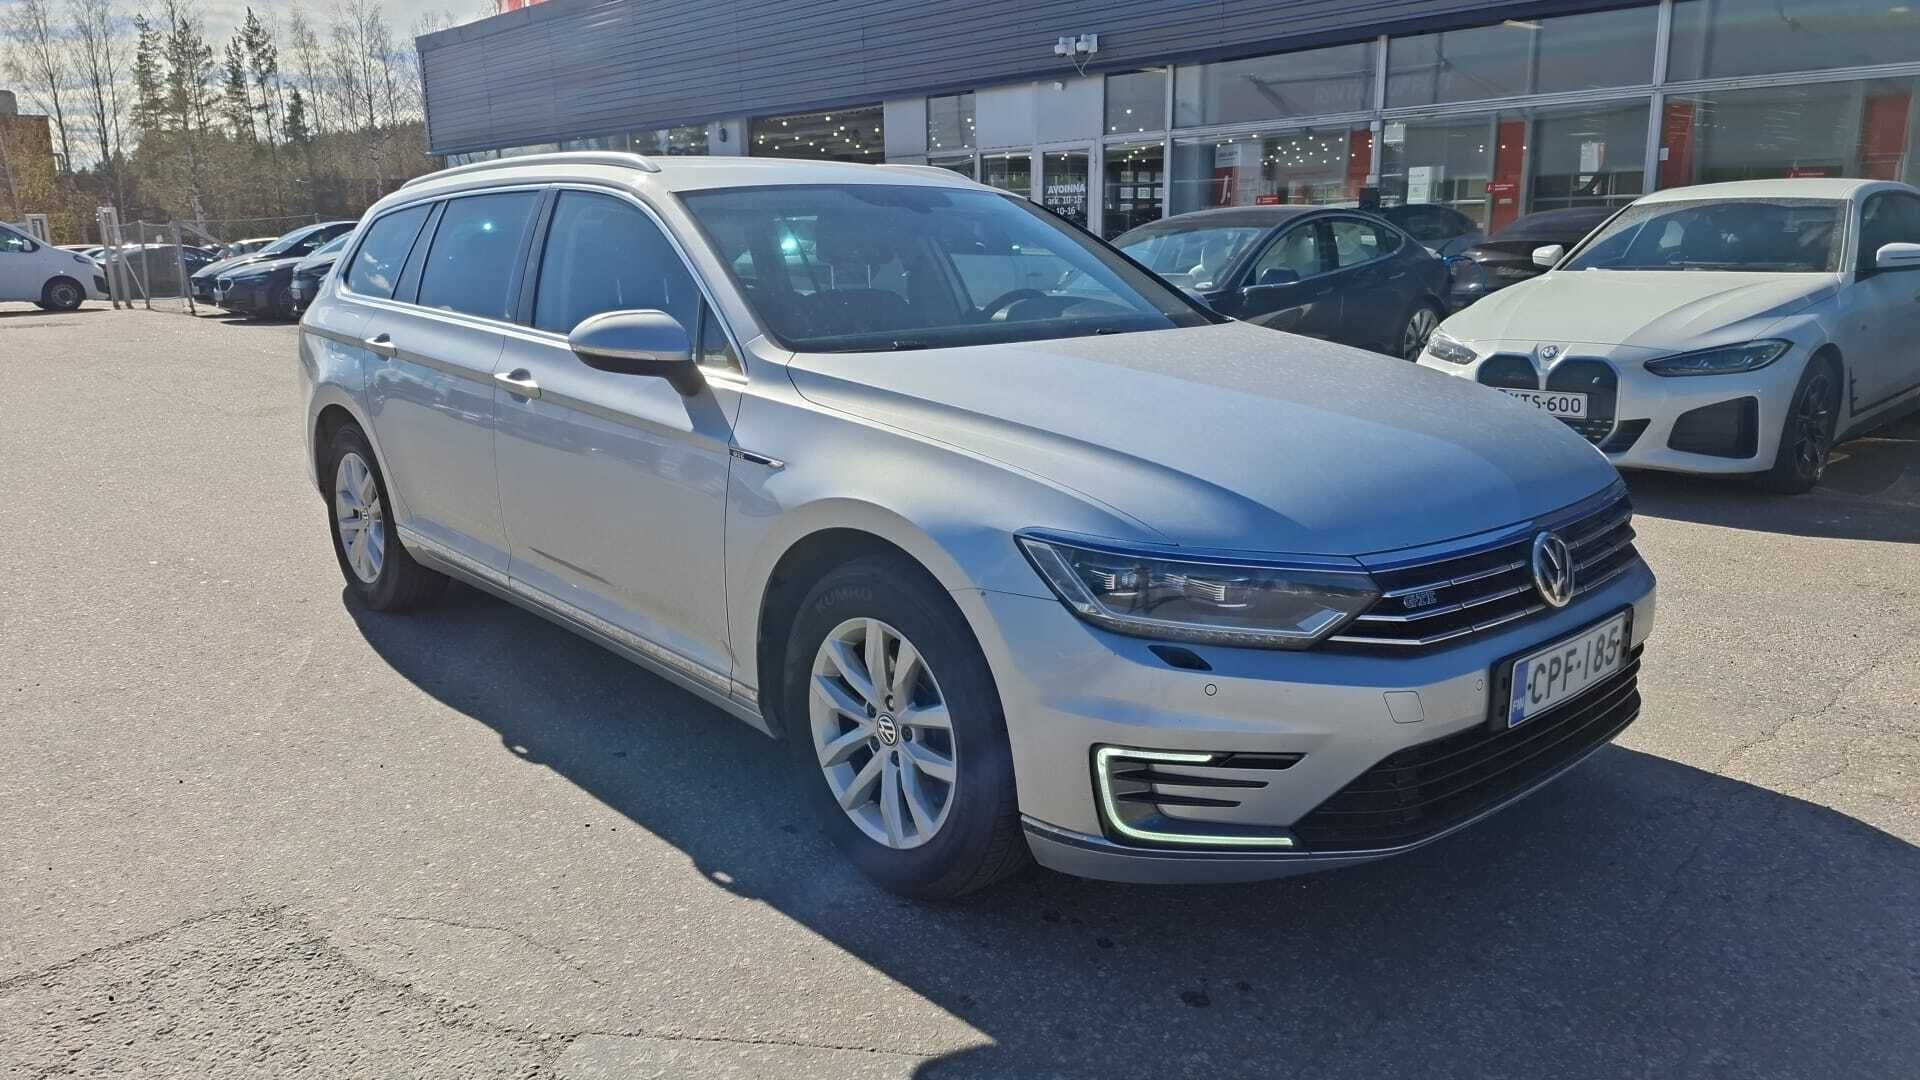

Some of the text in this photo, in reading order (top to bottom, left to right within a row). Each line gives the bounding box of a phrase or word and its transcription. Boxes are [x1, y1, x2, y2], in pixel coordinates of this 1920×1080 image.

[1047, 183, 1085, 194] AVOINNA
[1056, 206, 1076, 215] 10-16
[1531, 626, 1619, 705] CPF-185
